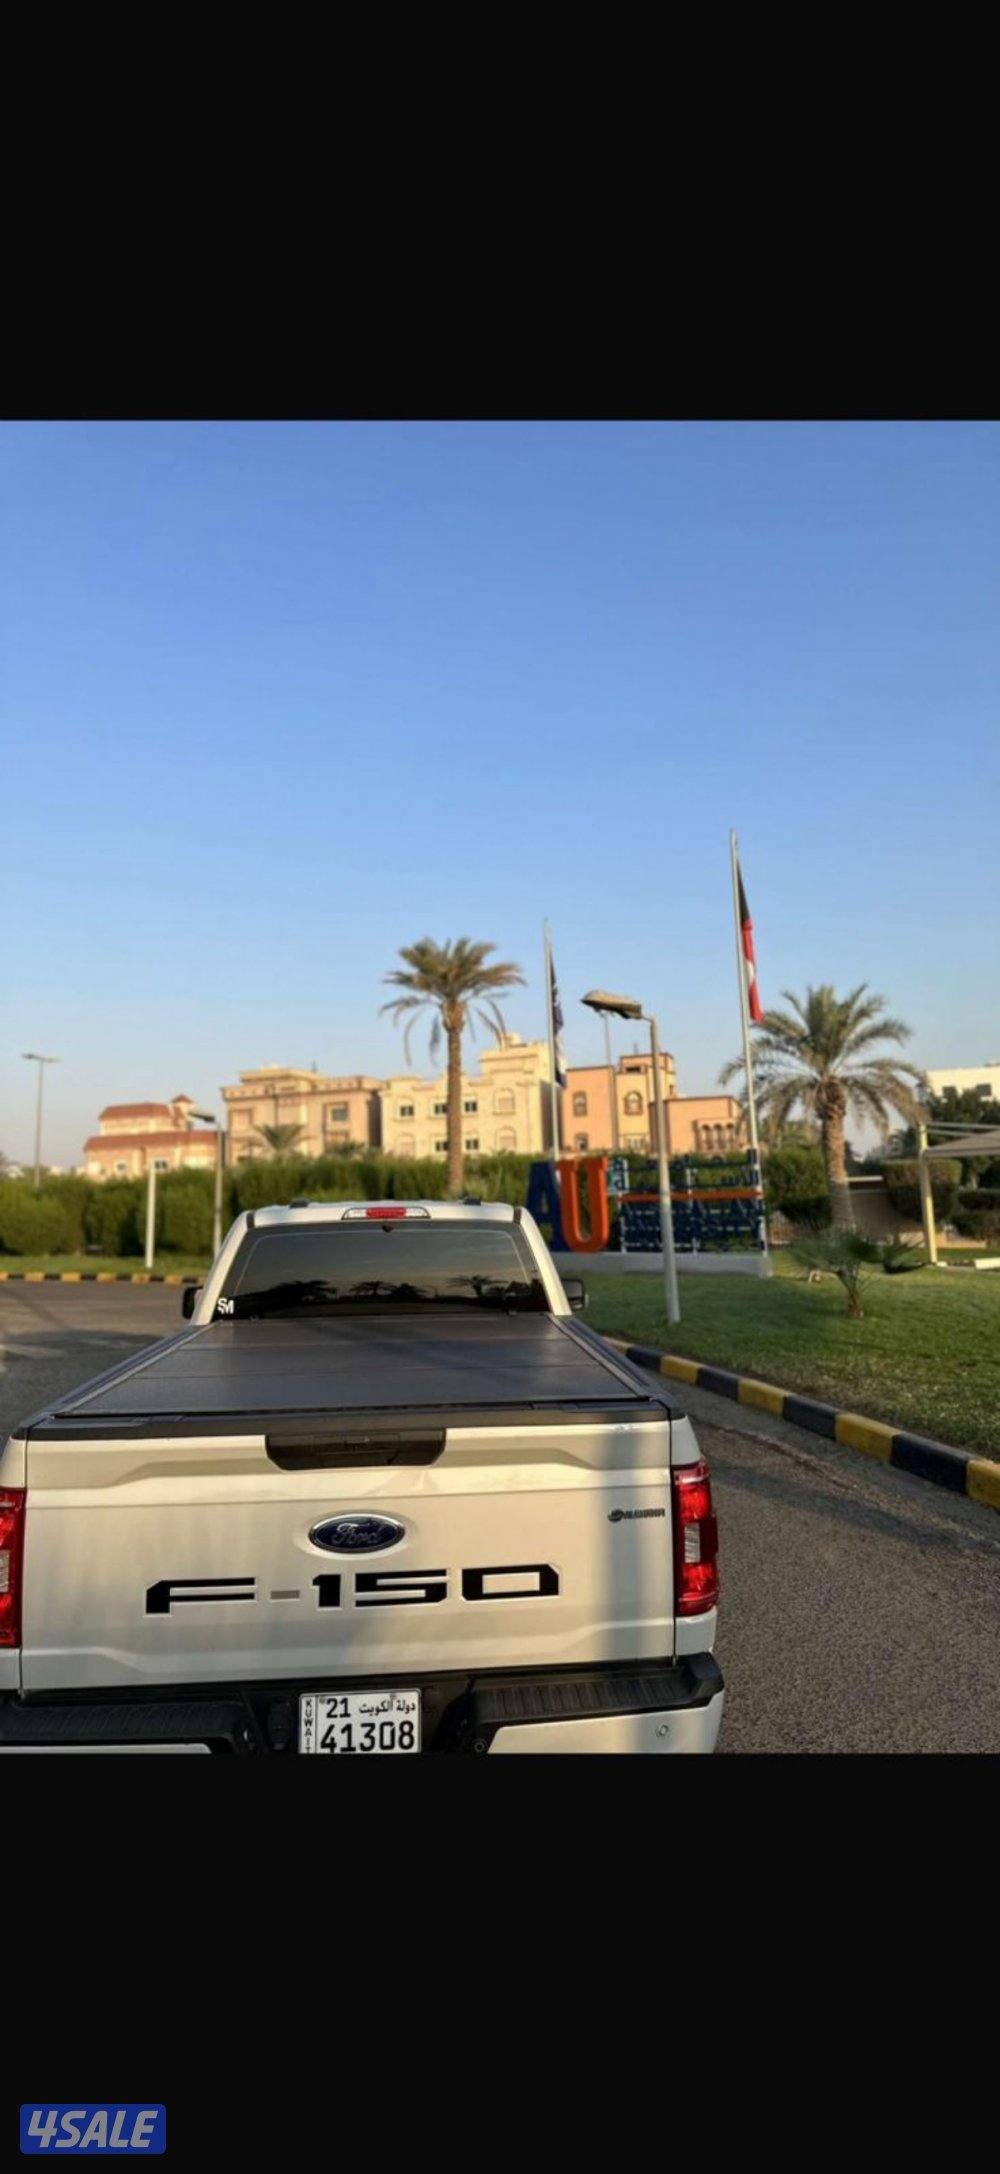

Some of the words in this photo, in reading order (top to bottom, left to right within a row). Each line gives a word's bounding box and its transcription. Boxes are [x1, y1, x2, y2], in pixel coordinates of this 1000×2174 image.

[526, 1156, 610, 1253] AU
[331, 1522, 384, 1545] Ford
[146, 1563, 560, 1614] F-150
[326, 1697, 351, 1718] 21
[358, 1700, 394, 1717] الكويت
[395, 1700, 416, 1714] دولة
[304, 1699, 314, 1754] KUWAIT
[320, 1720, 415, 1754] 41308
